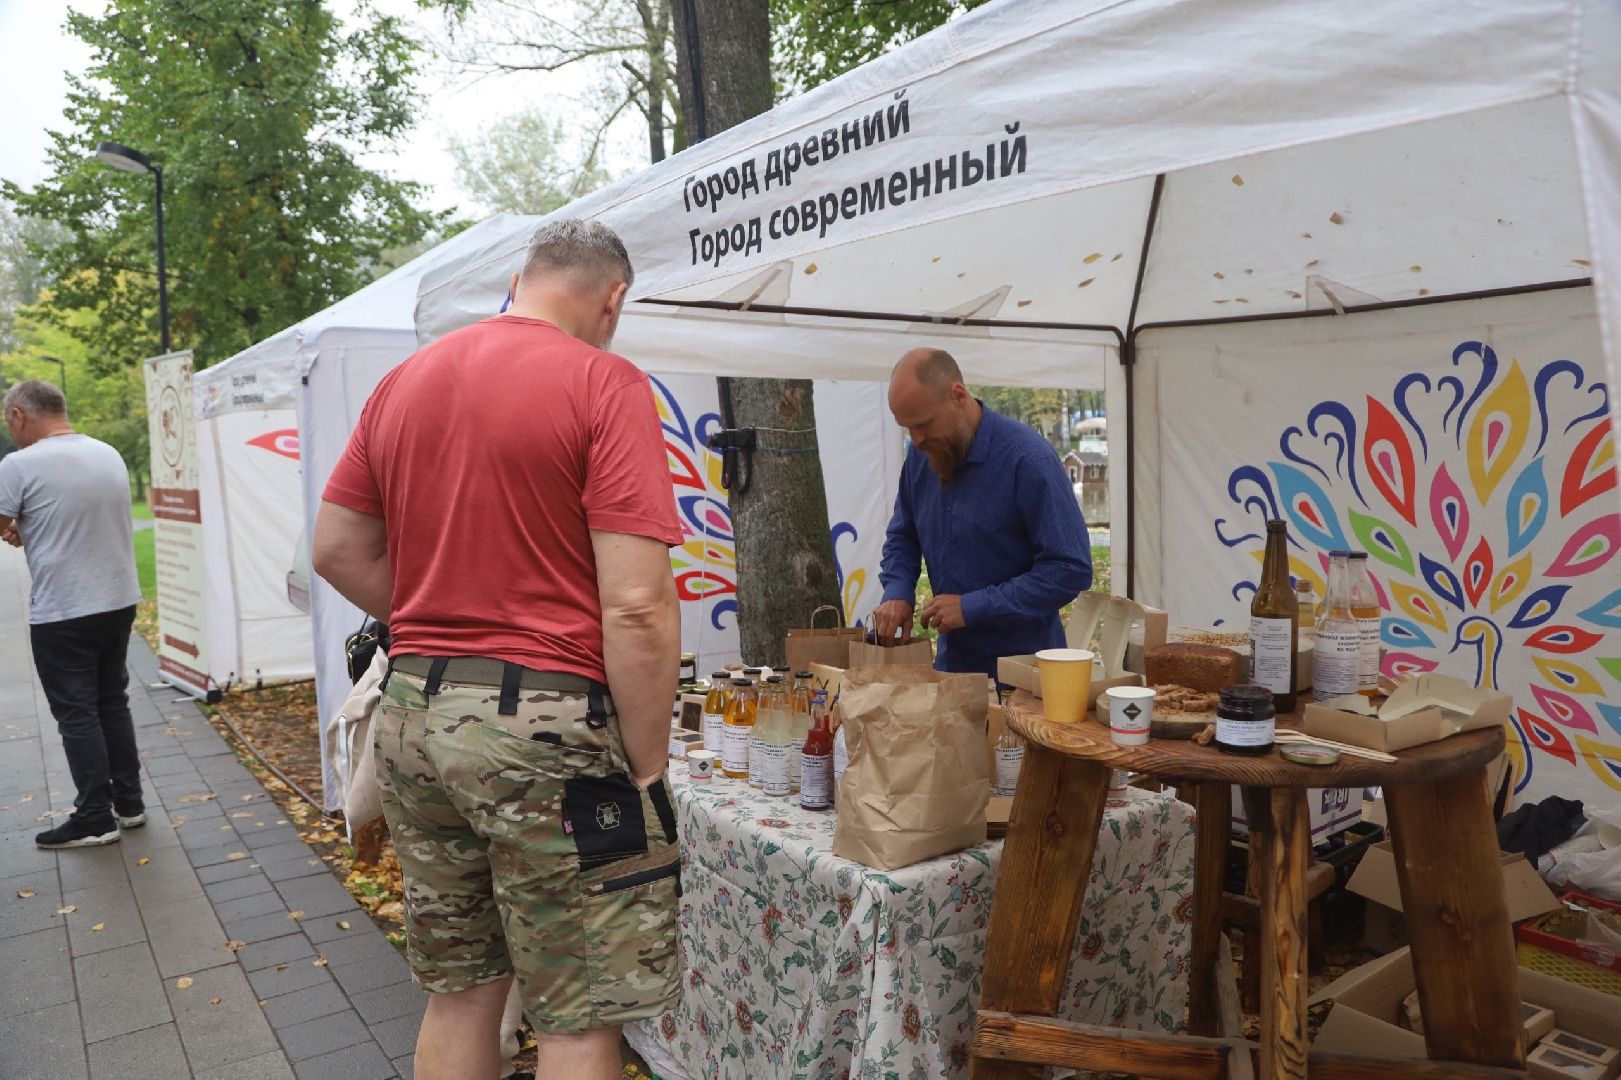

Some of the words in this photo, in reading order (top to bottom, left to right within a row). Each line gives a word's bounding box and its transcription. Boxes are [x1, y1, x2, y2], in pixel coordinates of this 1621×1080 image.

[684, 159, 759, 213] Город
[765, 90, 910, 189] древний
[689, 218, 762, 267] Город
[769, 121, 1027, 238] современный
